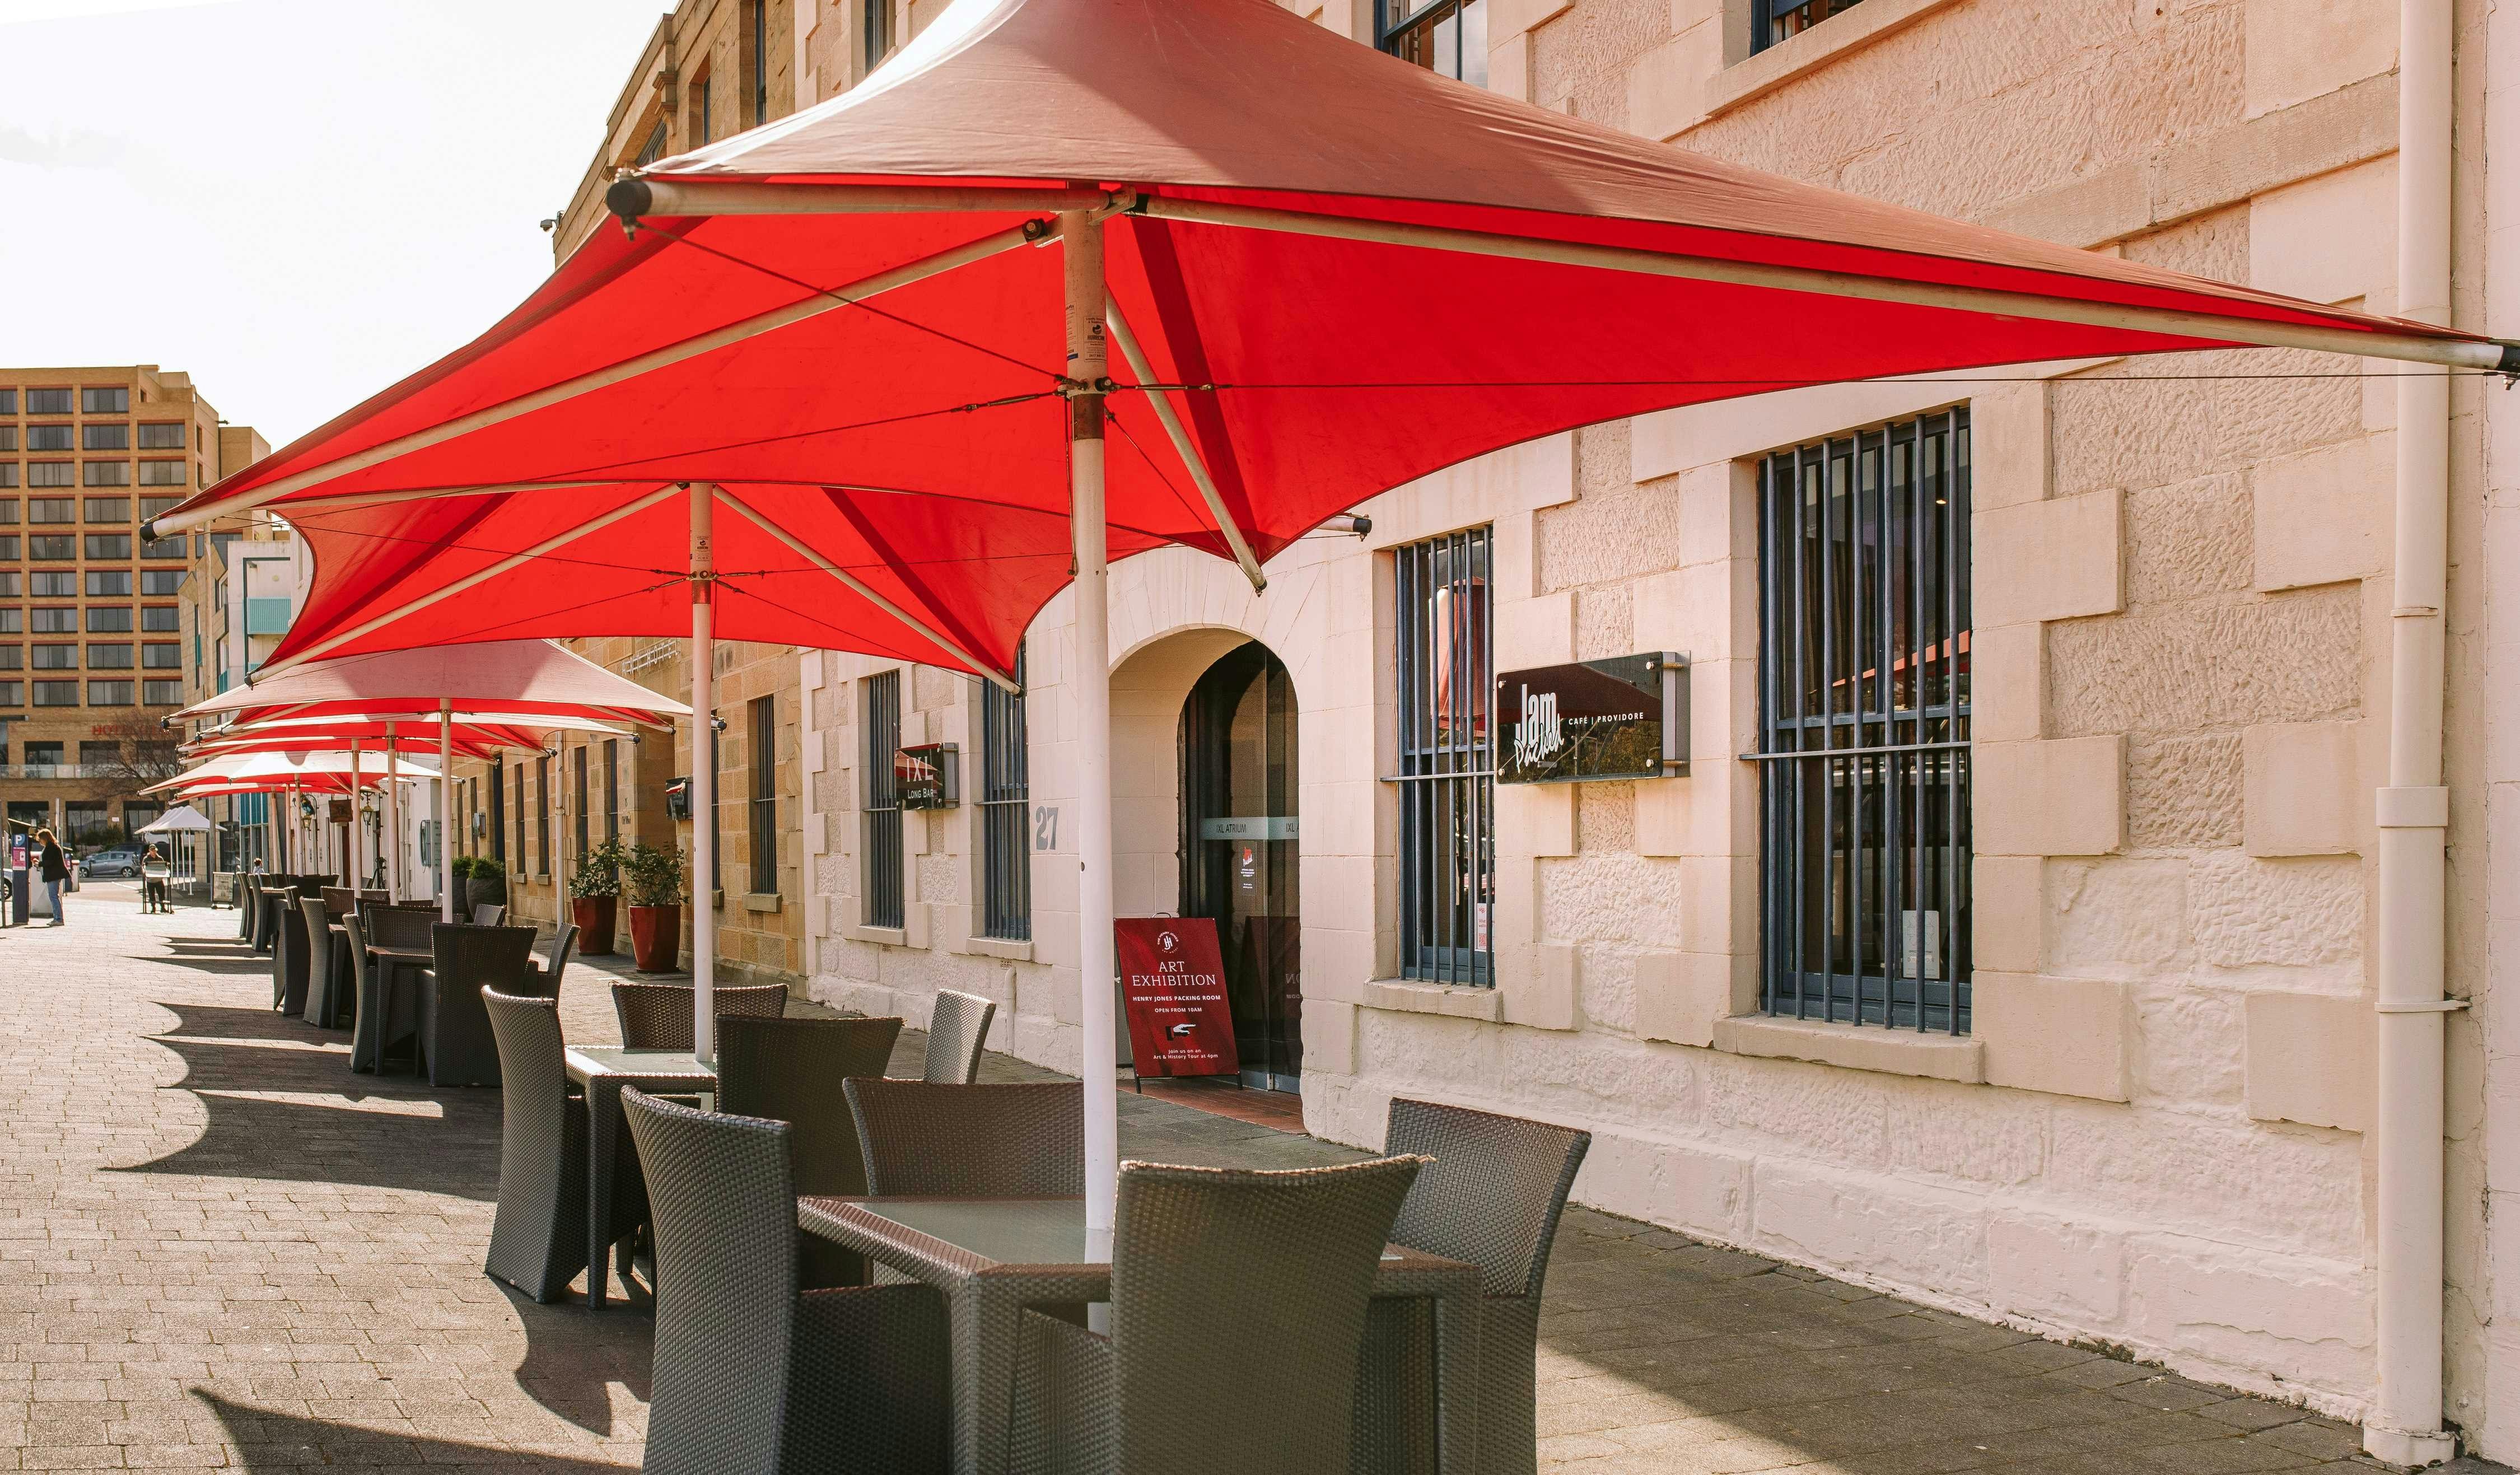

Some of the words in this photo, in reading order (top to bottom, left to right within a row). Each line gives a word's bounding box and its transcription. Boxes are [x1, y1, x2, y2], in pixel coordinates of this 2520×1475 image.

[1515, 684, 1556, 748] Jam
[1569, 716, 1588, 725] CAFÉ
[1597, 712, 1644, 723] PROVIDORE
[1514, 713, 1565, 774] Packed
[907, 756, 934, 782] IXL
[1036, 805, 1058, 851] 27
[1226, 824, 1247, 833] ATRIUM
[1286, 823, 1295, 832] IXL
[16, 834, 22, 845] P
[1159, 961, 1184, 972] ART
[1132, 974, 1216, 986] EXHIBITION
